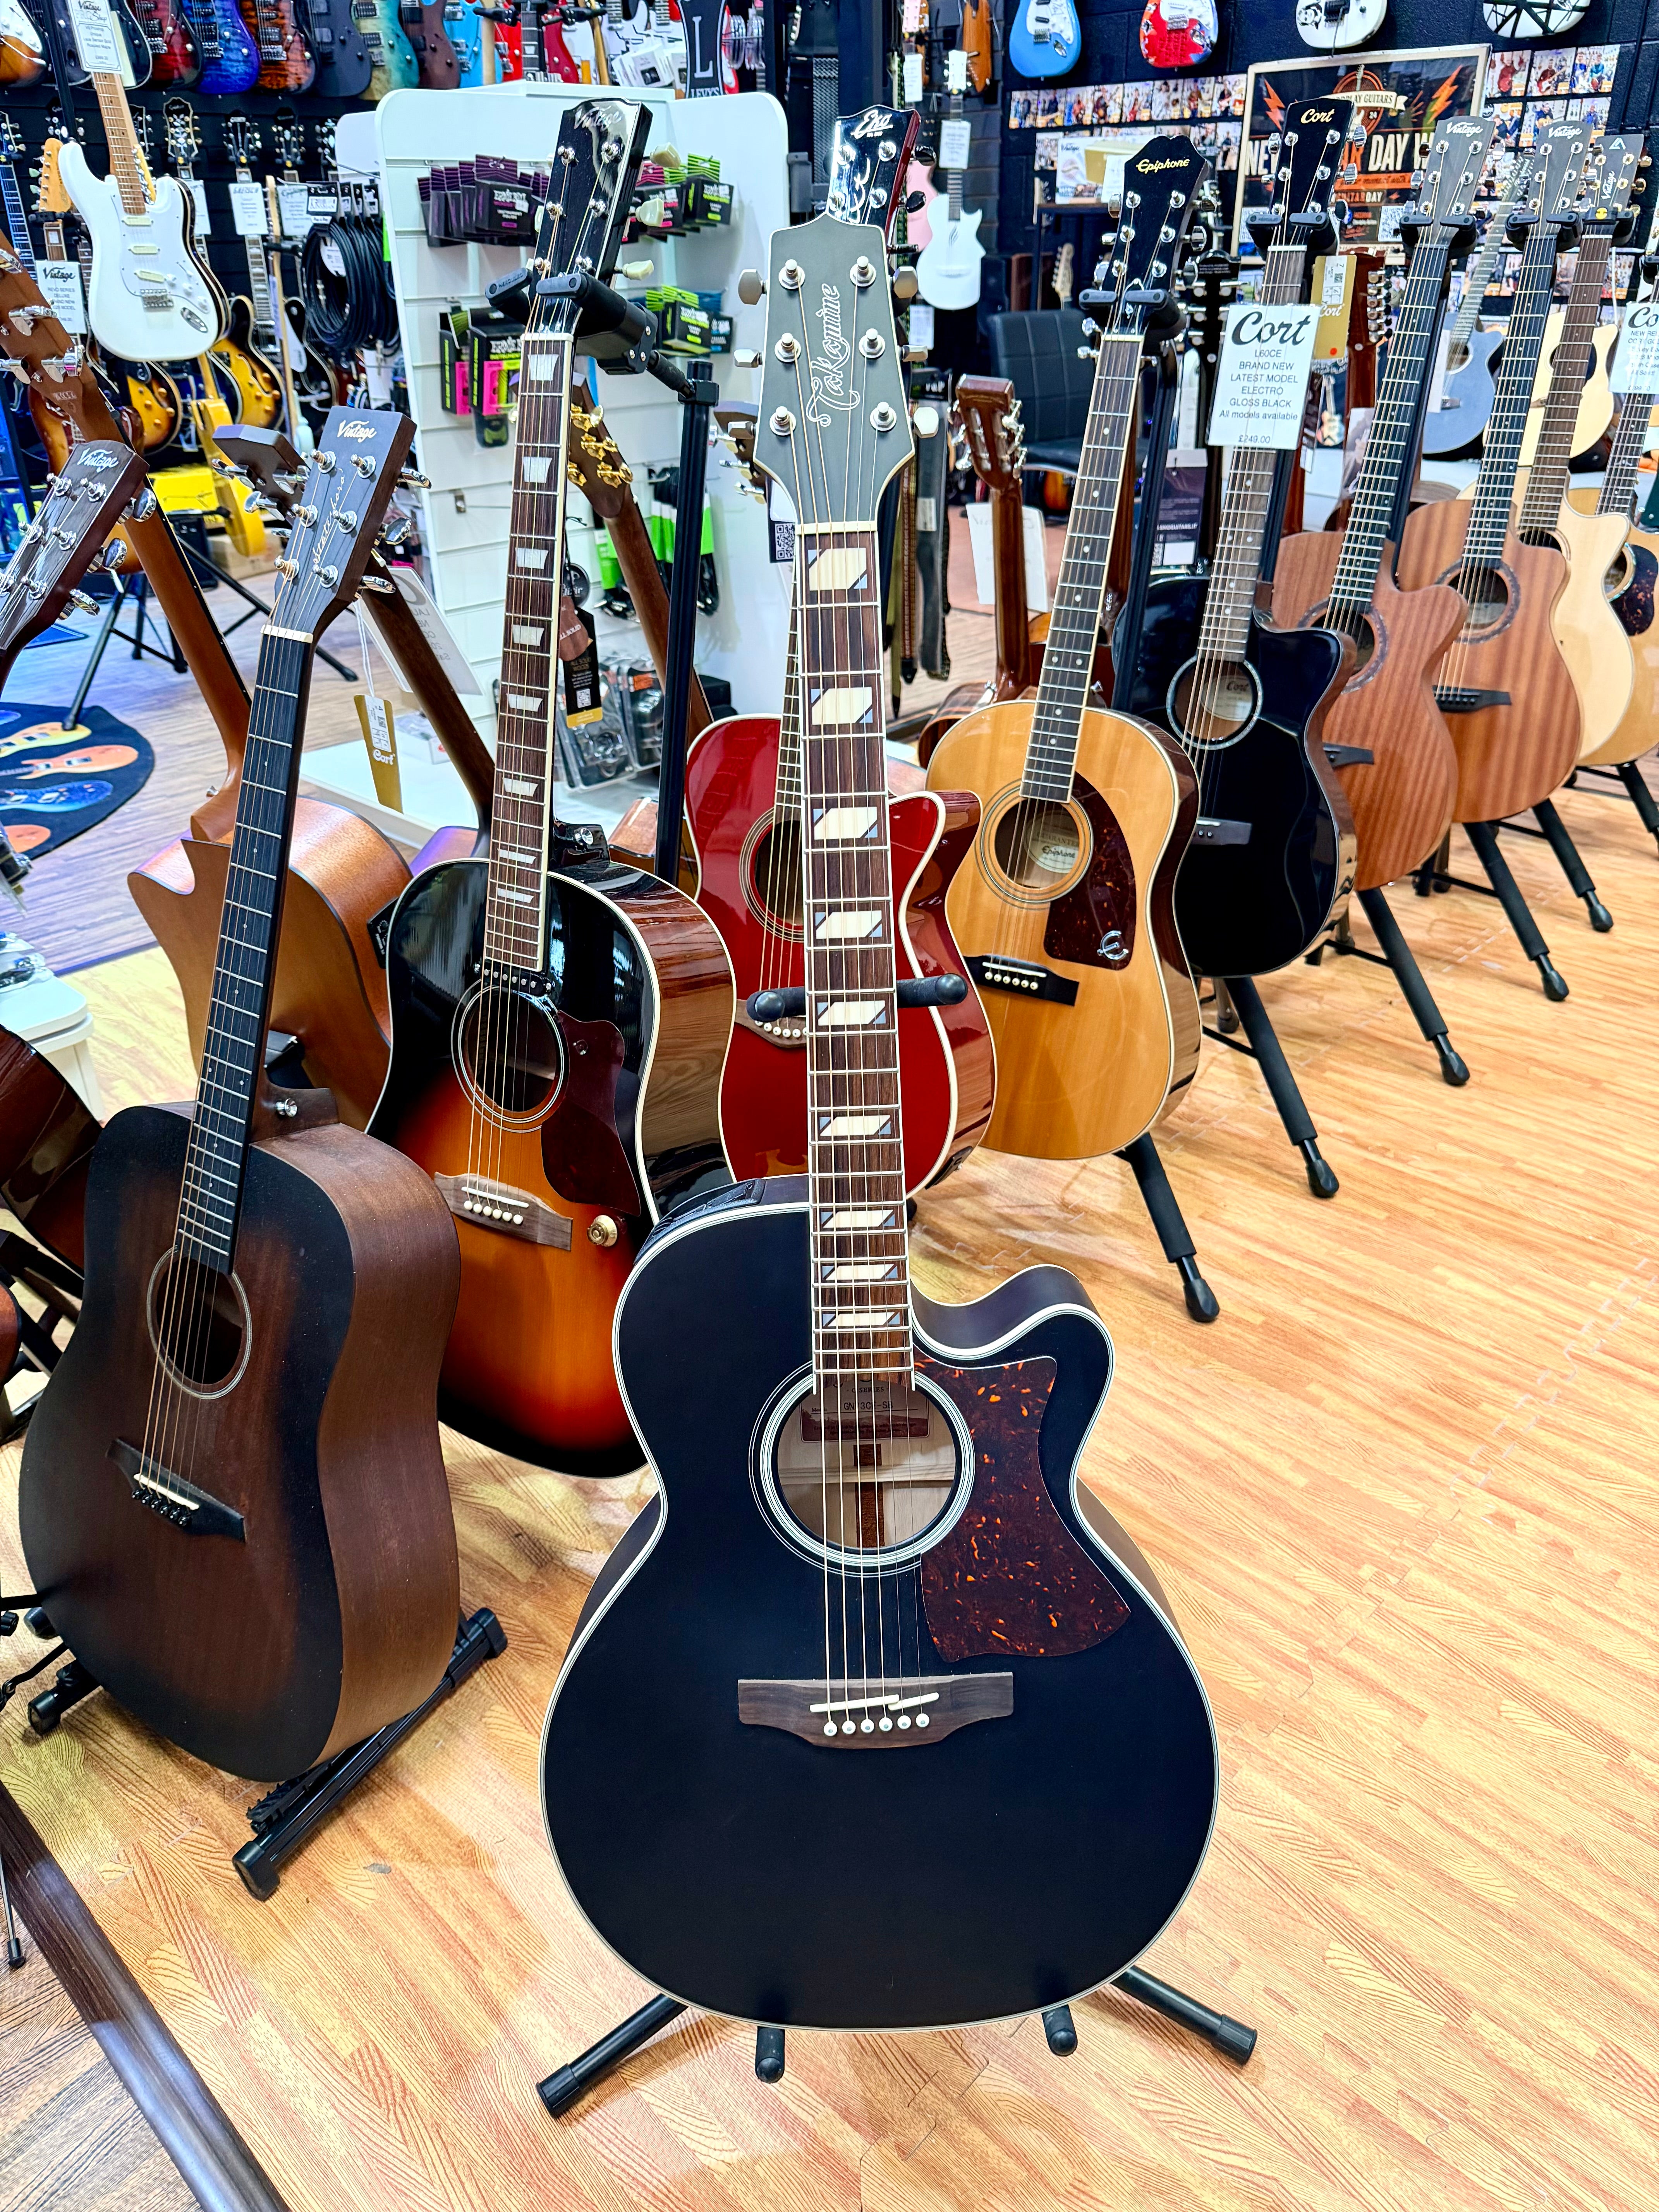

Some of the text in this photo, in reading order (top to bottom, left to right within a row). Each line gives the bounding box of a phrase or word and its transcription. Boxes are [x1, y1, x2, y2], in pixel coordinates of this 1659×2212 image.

[692, 16, 713, 78] L
[1364, 94, 1393, 104] GUITARS
[1300, 108, 1335, 124] Cort
[850, 110, 893, 139] Eko
[1446, 122, 1484, 137] Vintage
[1548, 125, 1582, 139] Vintage
[1368, 133, 1410, 171] DAY
[1136, 158, 1190, 174] Epiphone
[1601, 170, 1617, 200] Vintage
[43, 267, 76, 283] Vintage
[1319, 305, 1343, 317] Cort
[1231, 311, 1311, 346] Cort
[806, 283, 860, 427] Takamine
[1254, 349, 1282, 358] L60CE
[1239, 361, 1294, 371] BRAND NEW
[1230, 373, 1298, 383] LATEST MODEL
[1241, 386, 1284, 395] ELECTRO
[1230, 398, 1291, 408] GLOSS BLACK
[1219, 410, 1298, 421] All models available
[337, 419, 377, 443] Vintage
[1238, 434, 1271, 443] £249.00
[77, 448, 118, 473] Vintage
[566, 624, 581, 636] SOLID
[1226, 681, 1249, 691] Cort
[373, 749, 393, 765] Cort
[1042, 845, 1076, 859] Epiphone
[843, 1401, 893, 1410] GN3C-SB
